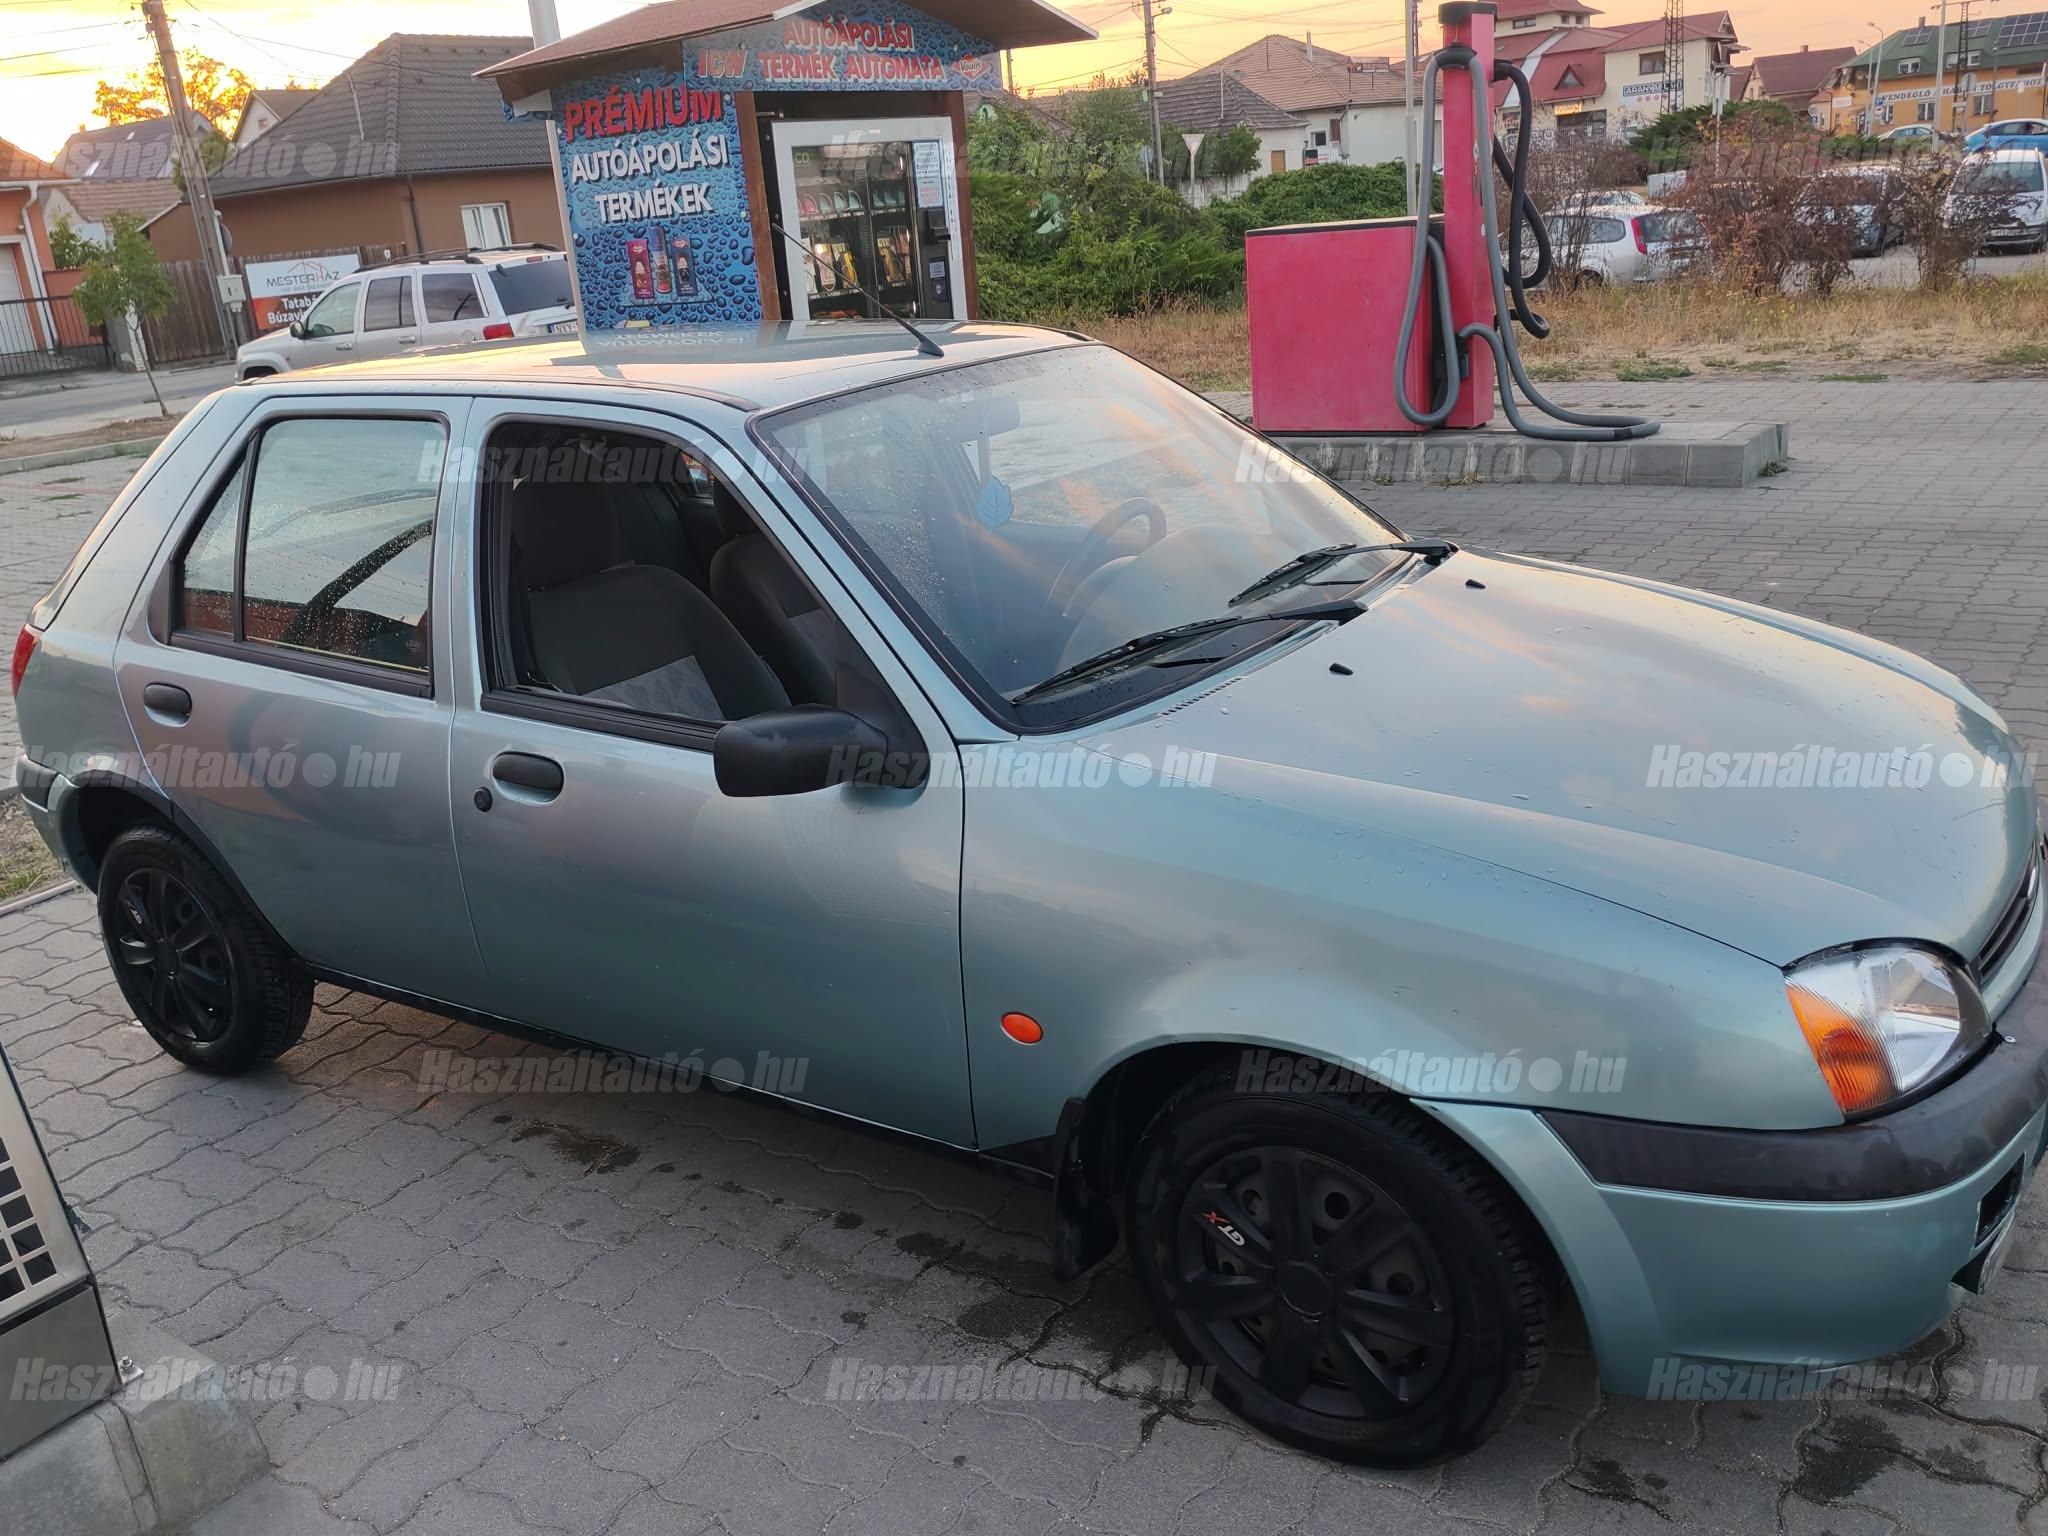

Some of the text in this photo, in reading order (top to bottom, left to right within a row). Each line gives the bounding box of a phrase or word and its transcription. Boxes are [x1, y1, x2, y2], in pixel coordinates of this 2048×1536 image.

[783, 14, 915, 51] AUTÓÁPOLÁSI
[757, 49, 840, 81] TERMÉK
[847, 54, 946, 82] AUTOMATA
[565, 84, 722, 143] PRÉMIUM
[571, 128, 731, 183] AUTÓÁPOLÁSI
[594, 178, 714, 223] TERMÉKEK
